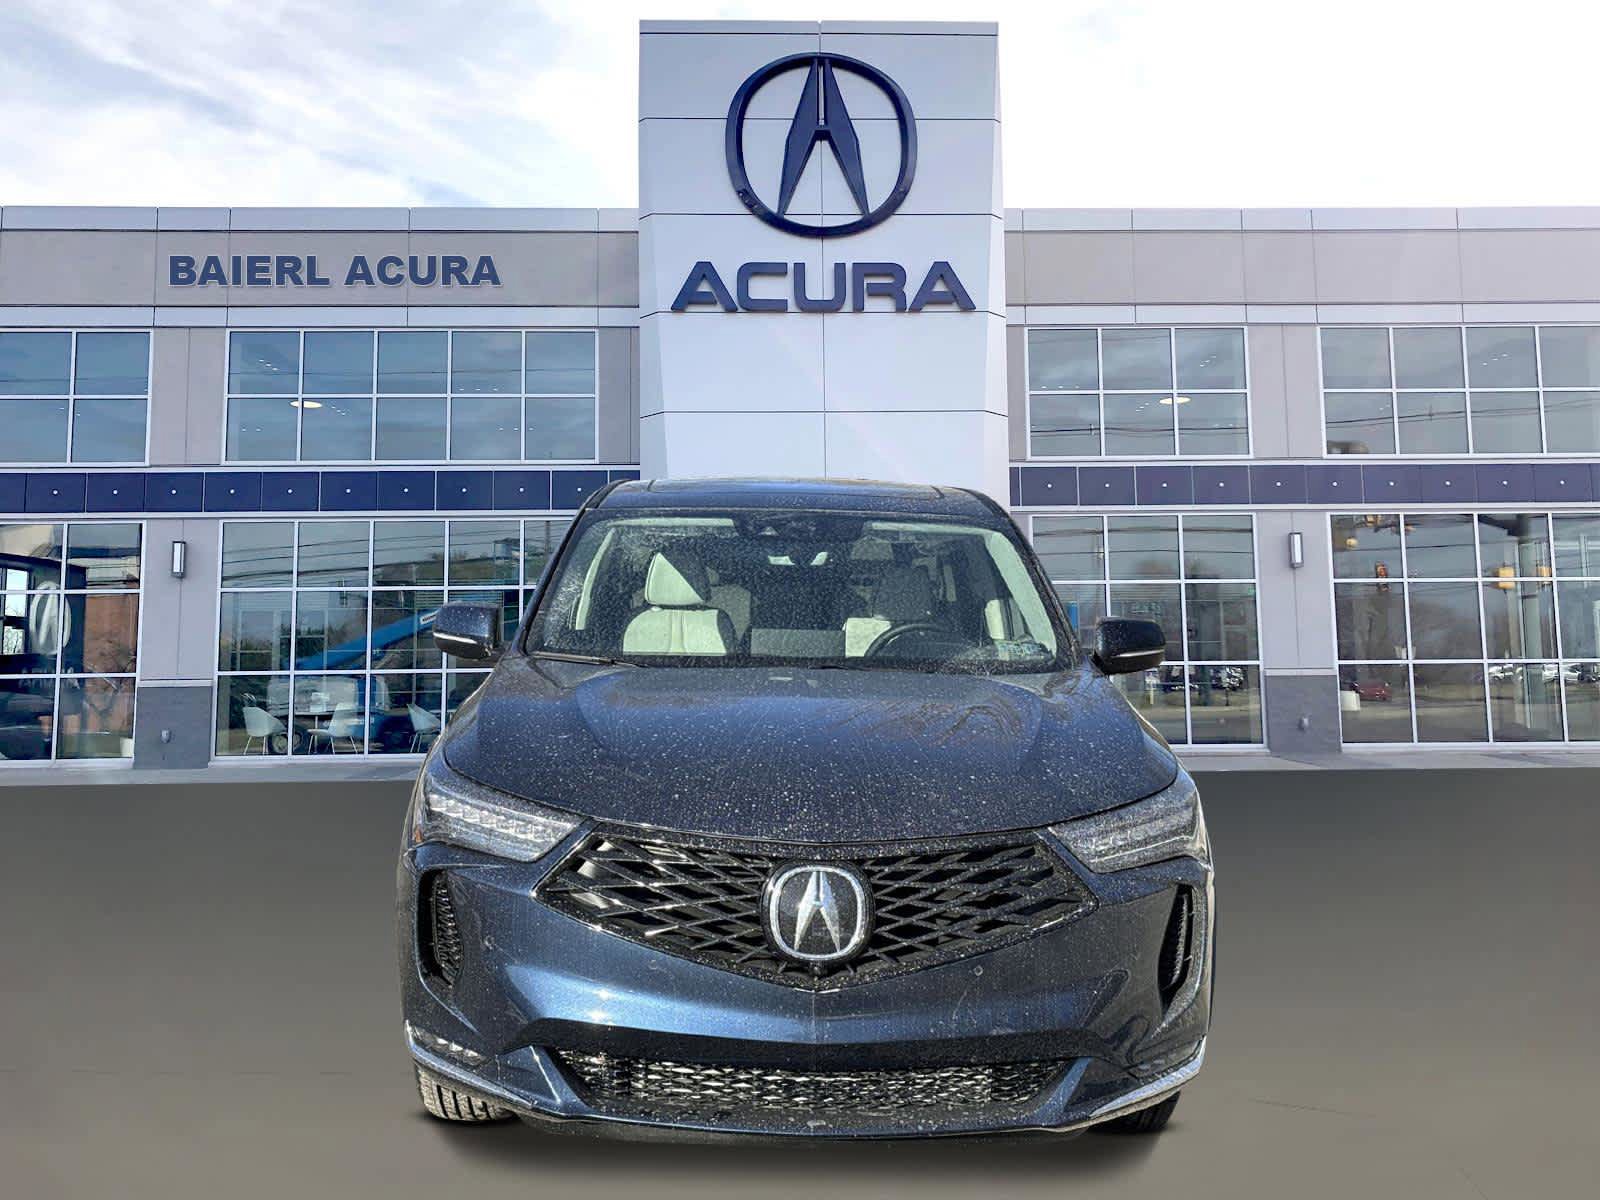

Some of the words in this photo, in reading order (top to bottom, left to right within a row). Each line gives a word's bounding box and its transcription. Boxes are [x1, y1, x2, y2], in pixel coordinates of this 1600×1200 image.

[169, 255, 330, 286] BAIERL
[343, 255, 501, 286] ACURA
[670, 261, 977, 313] ACURA
